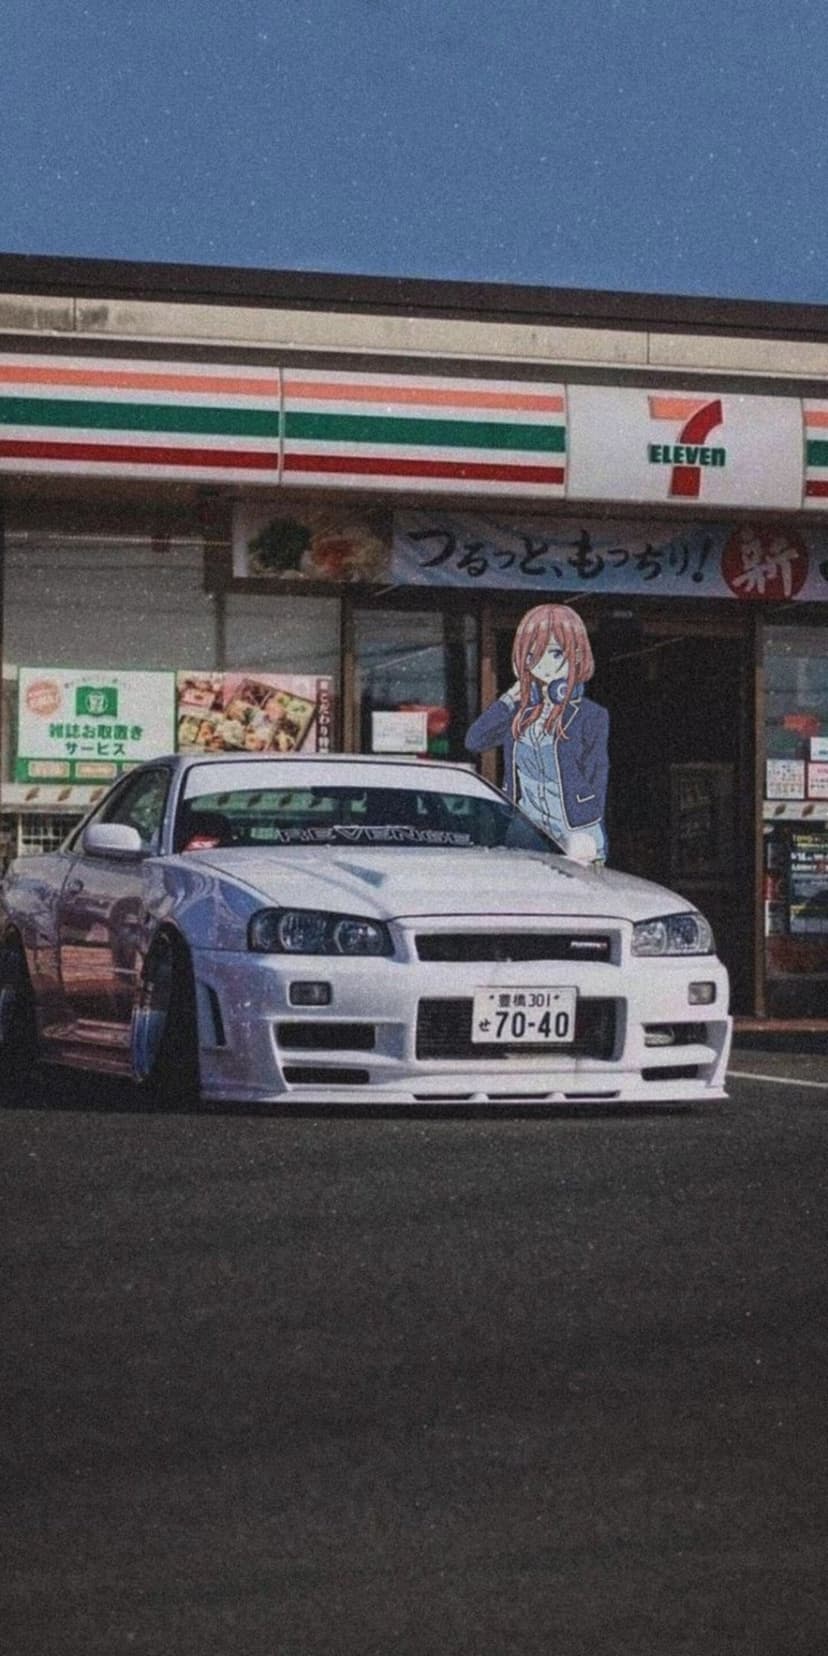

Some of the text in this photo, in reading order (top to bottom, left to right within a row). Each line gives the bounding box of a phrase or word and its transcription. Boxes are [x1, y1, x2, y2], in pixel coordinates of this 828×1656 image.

[648, 396, 723, 499] 7
[732, 537, 800, 597] 新
[49, 723, 143, 740] 雑誌お取置き
[65, 742, 125, 755] サービス
[478, 1011, 569, 1038] せ 70-40
